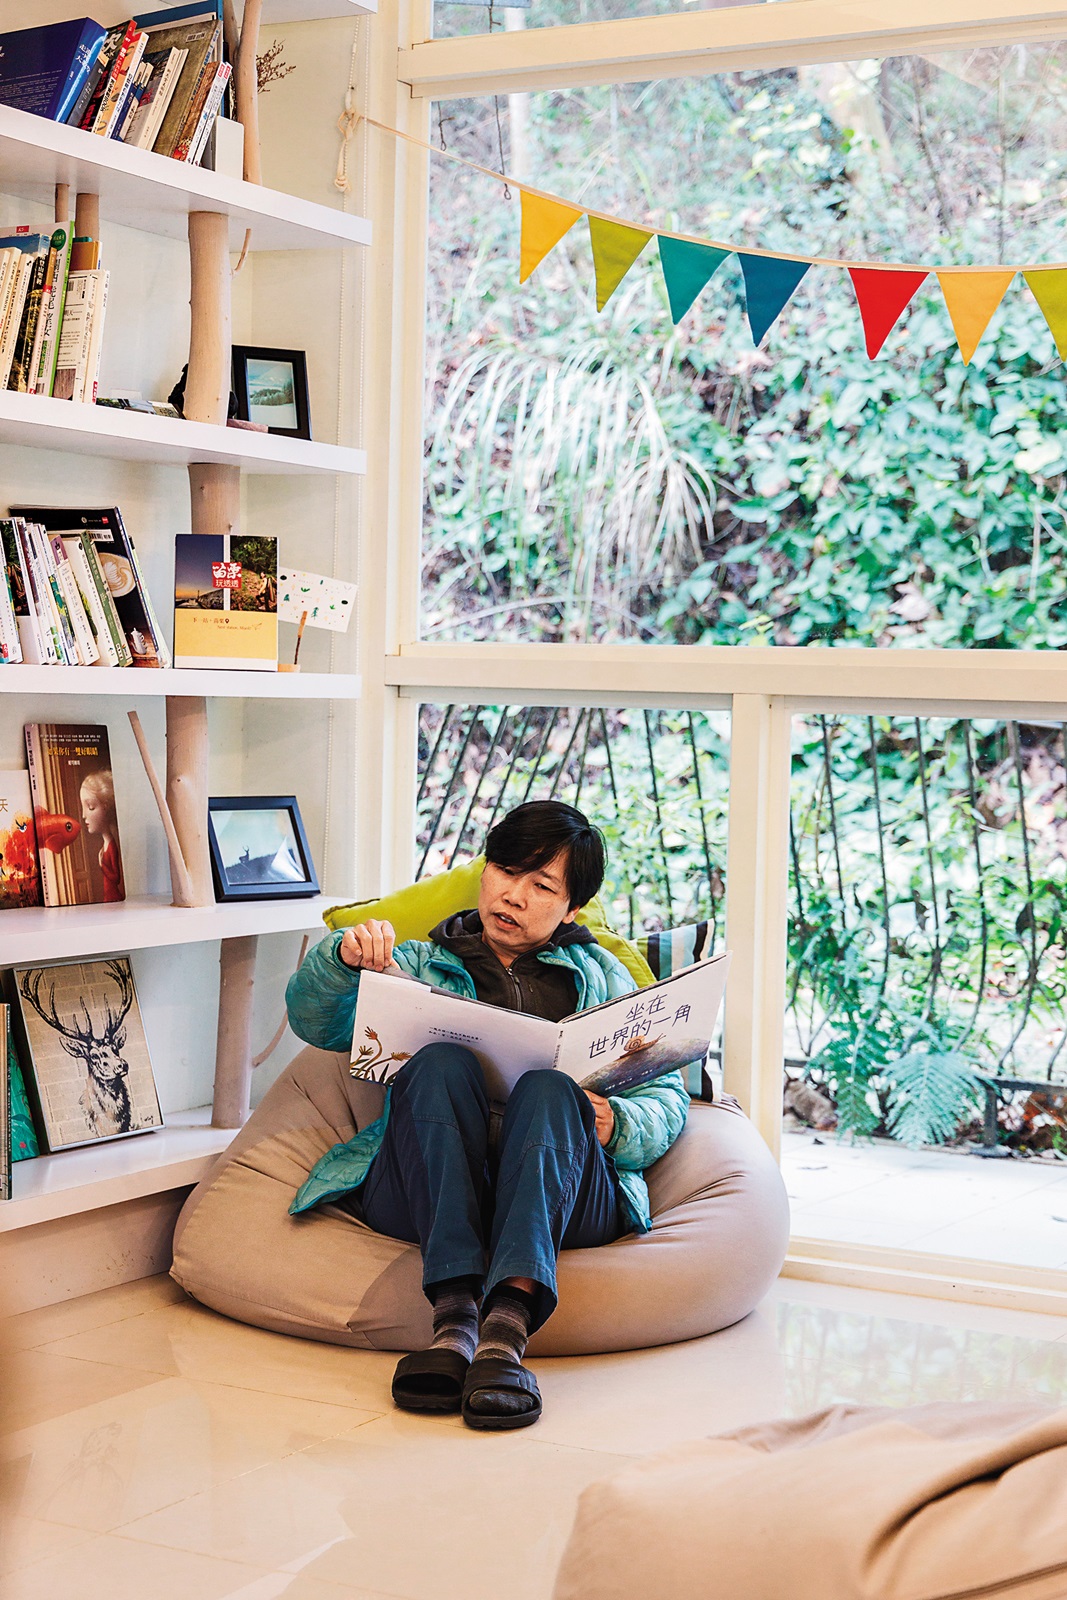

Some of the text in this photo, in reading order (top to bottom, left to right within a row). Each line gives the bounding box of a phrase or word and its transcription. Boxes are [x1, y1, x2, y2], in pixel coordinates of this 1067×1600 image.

[216, 579, 239, 588] 玩透透
[624, 993, 668, 1025] 坐在
[589, 1004, 691, 1058] 世界的一角
